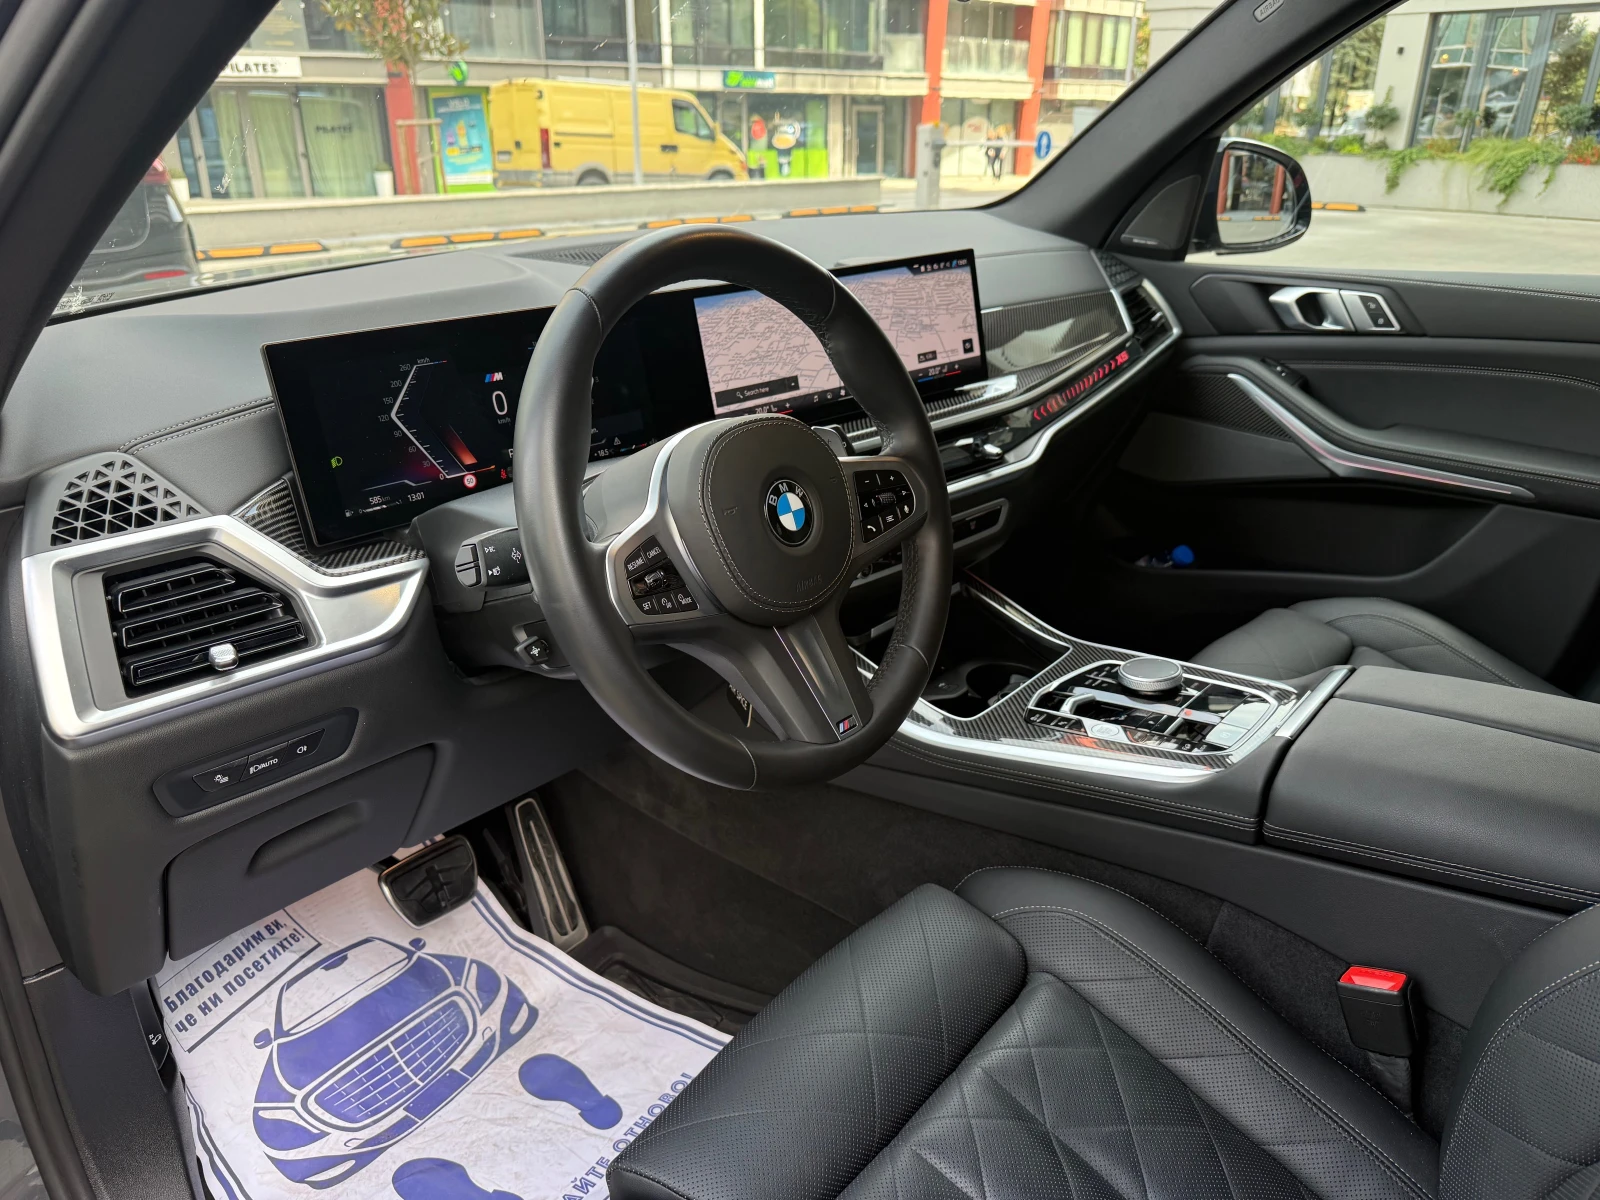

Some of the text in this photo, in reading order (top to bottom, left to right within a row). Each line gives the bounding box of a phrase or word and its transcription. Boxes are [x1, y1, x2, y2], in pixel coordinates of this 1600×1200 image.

[222, 63, 279, 74] ILATES
[399, 363, 412, 372] 260
[389, 380, 402, 388] 200
[743, 388, 759, 397] Search
[382, 396, 394, 405] 150
[492, 390, 508, 415] 0
[378, 414, 390, 422] 120
[393, 430, 403, 438] 90
[408, 445, 417, 453] 60
[422, 460, 431, 468] 30
[439, 473, 445, 481] 0
[466, 477, 474, 485] 50
[407, 491, 425, 502] 13:01
[768, 482, 804, 507] BMW
[369, 495, 382, 505] 585
[627, 546, 661, 571] RESUME CANCEL
[642, 601, 652, 611] SET
[261, 758, 278, 769] AUTO
[163, 918, 288, 1014] Благодарим ви,
[174, 928, 306, 1034] че ни посетихте!
